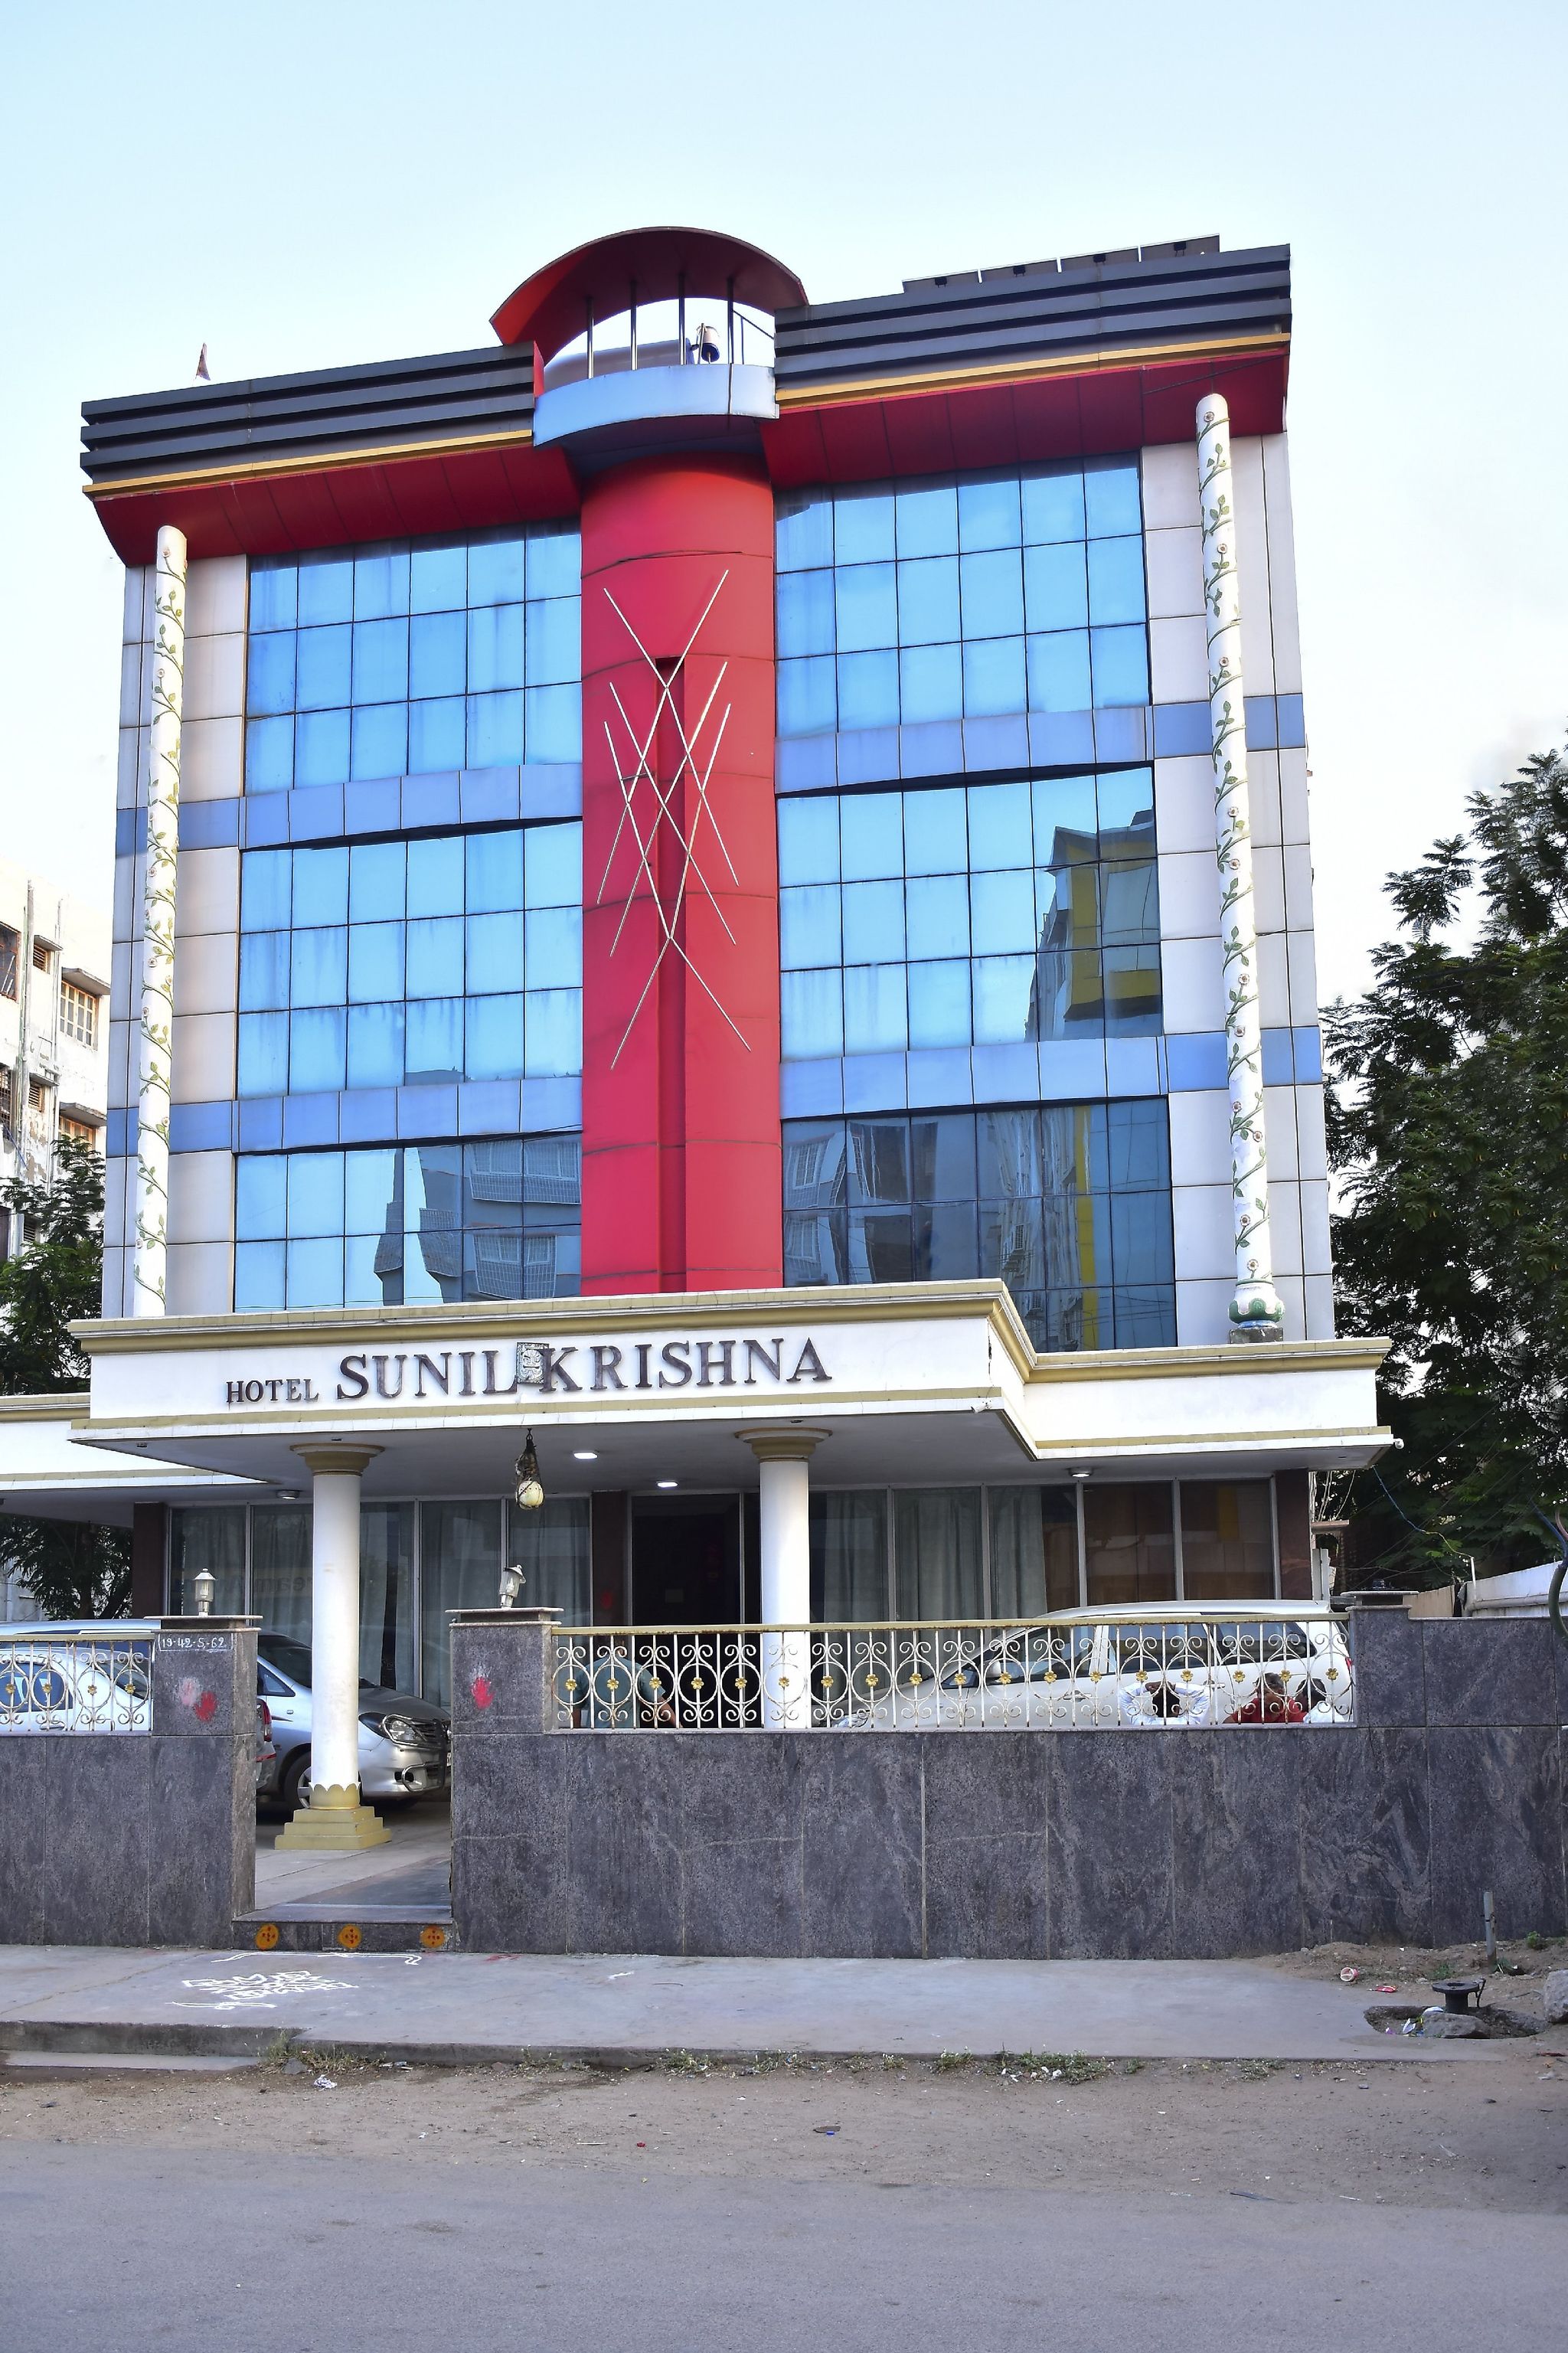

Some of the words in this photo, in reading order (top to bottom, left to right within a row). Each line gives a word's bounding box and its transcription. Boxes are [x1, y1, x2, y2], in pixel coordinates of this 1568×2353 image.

[227, 1379, 318, 1403] HOTEL
[337, 1350, 518, 1400] SUNIL
[537, 1337, 832, 1393] KRISHNA
